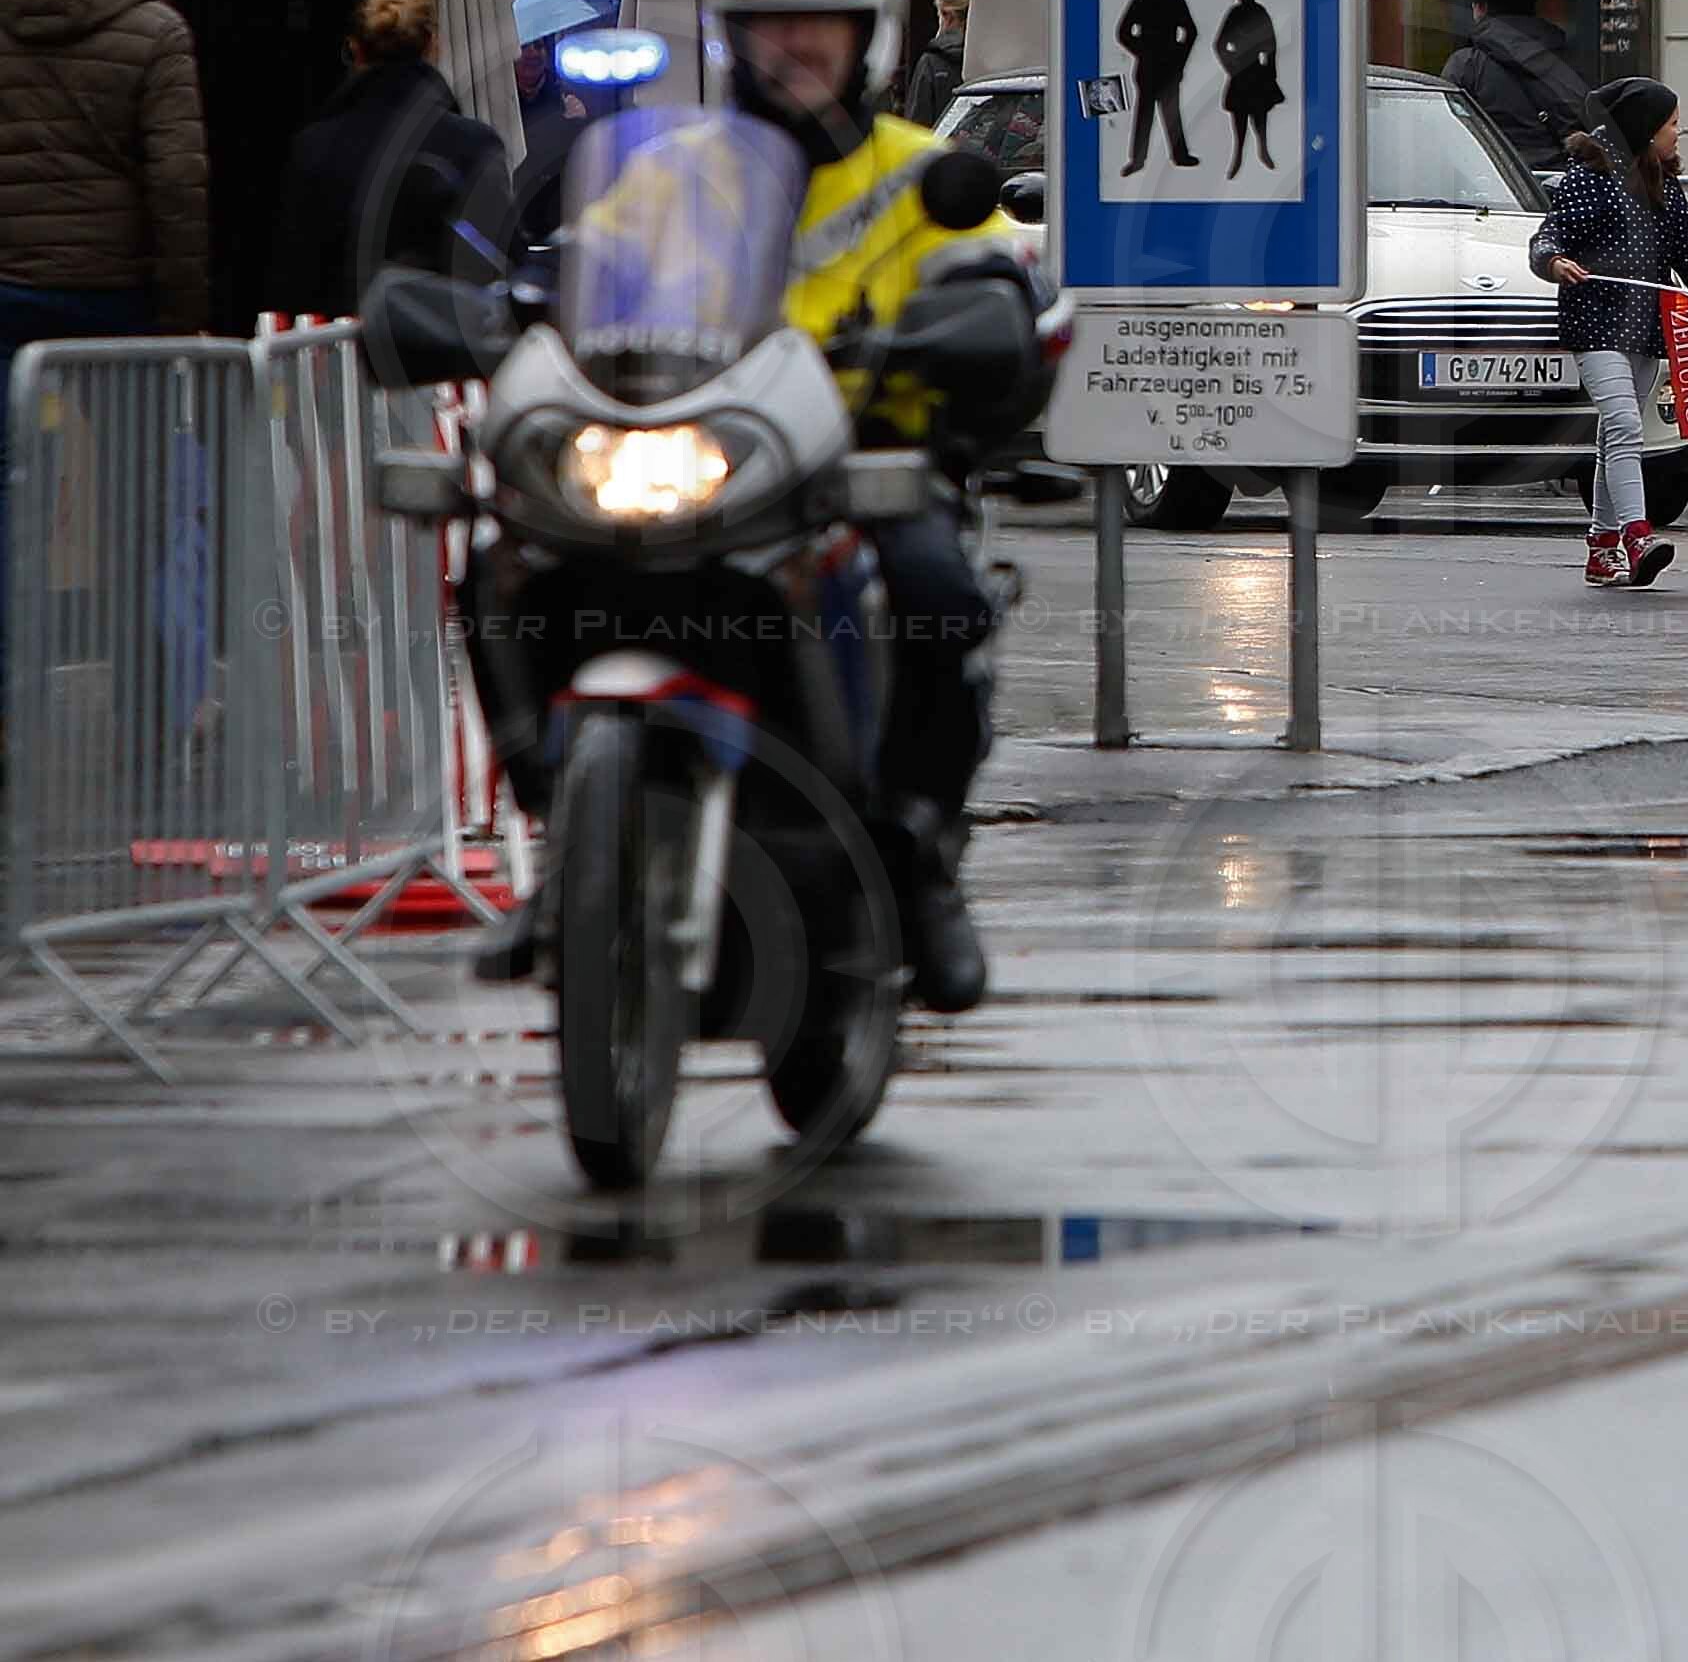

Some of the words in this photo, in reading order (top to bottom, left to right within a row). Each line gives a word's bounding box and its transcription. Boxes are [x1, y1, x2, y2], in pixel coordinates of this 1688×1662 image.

[1118, 321, 1285, 341] ausgenommen
[1103, 344, 1252, 371] Ladetätigkeit
[1262, 347, 1299, 366] mit
[1450, 357, 1464, 383] G
[1482, 357, 1527, 383] 742
[1534, 357, 1563, 383] NJ
[1087, 372, 1221, 398] Fahrzeugen
[1232, 373, 1263, 395] bis
[1147, 407, 1165, 425] v.
